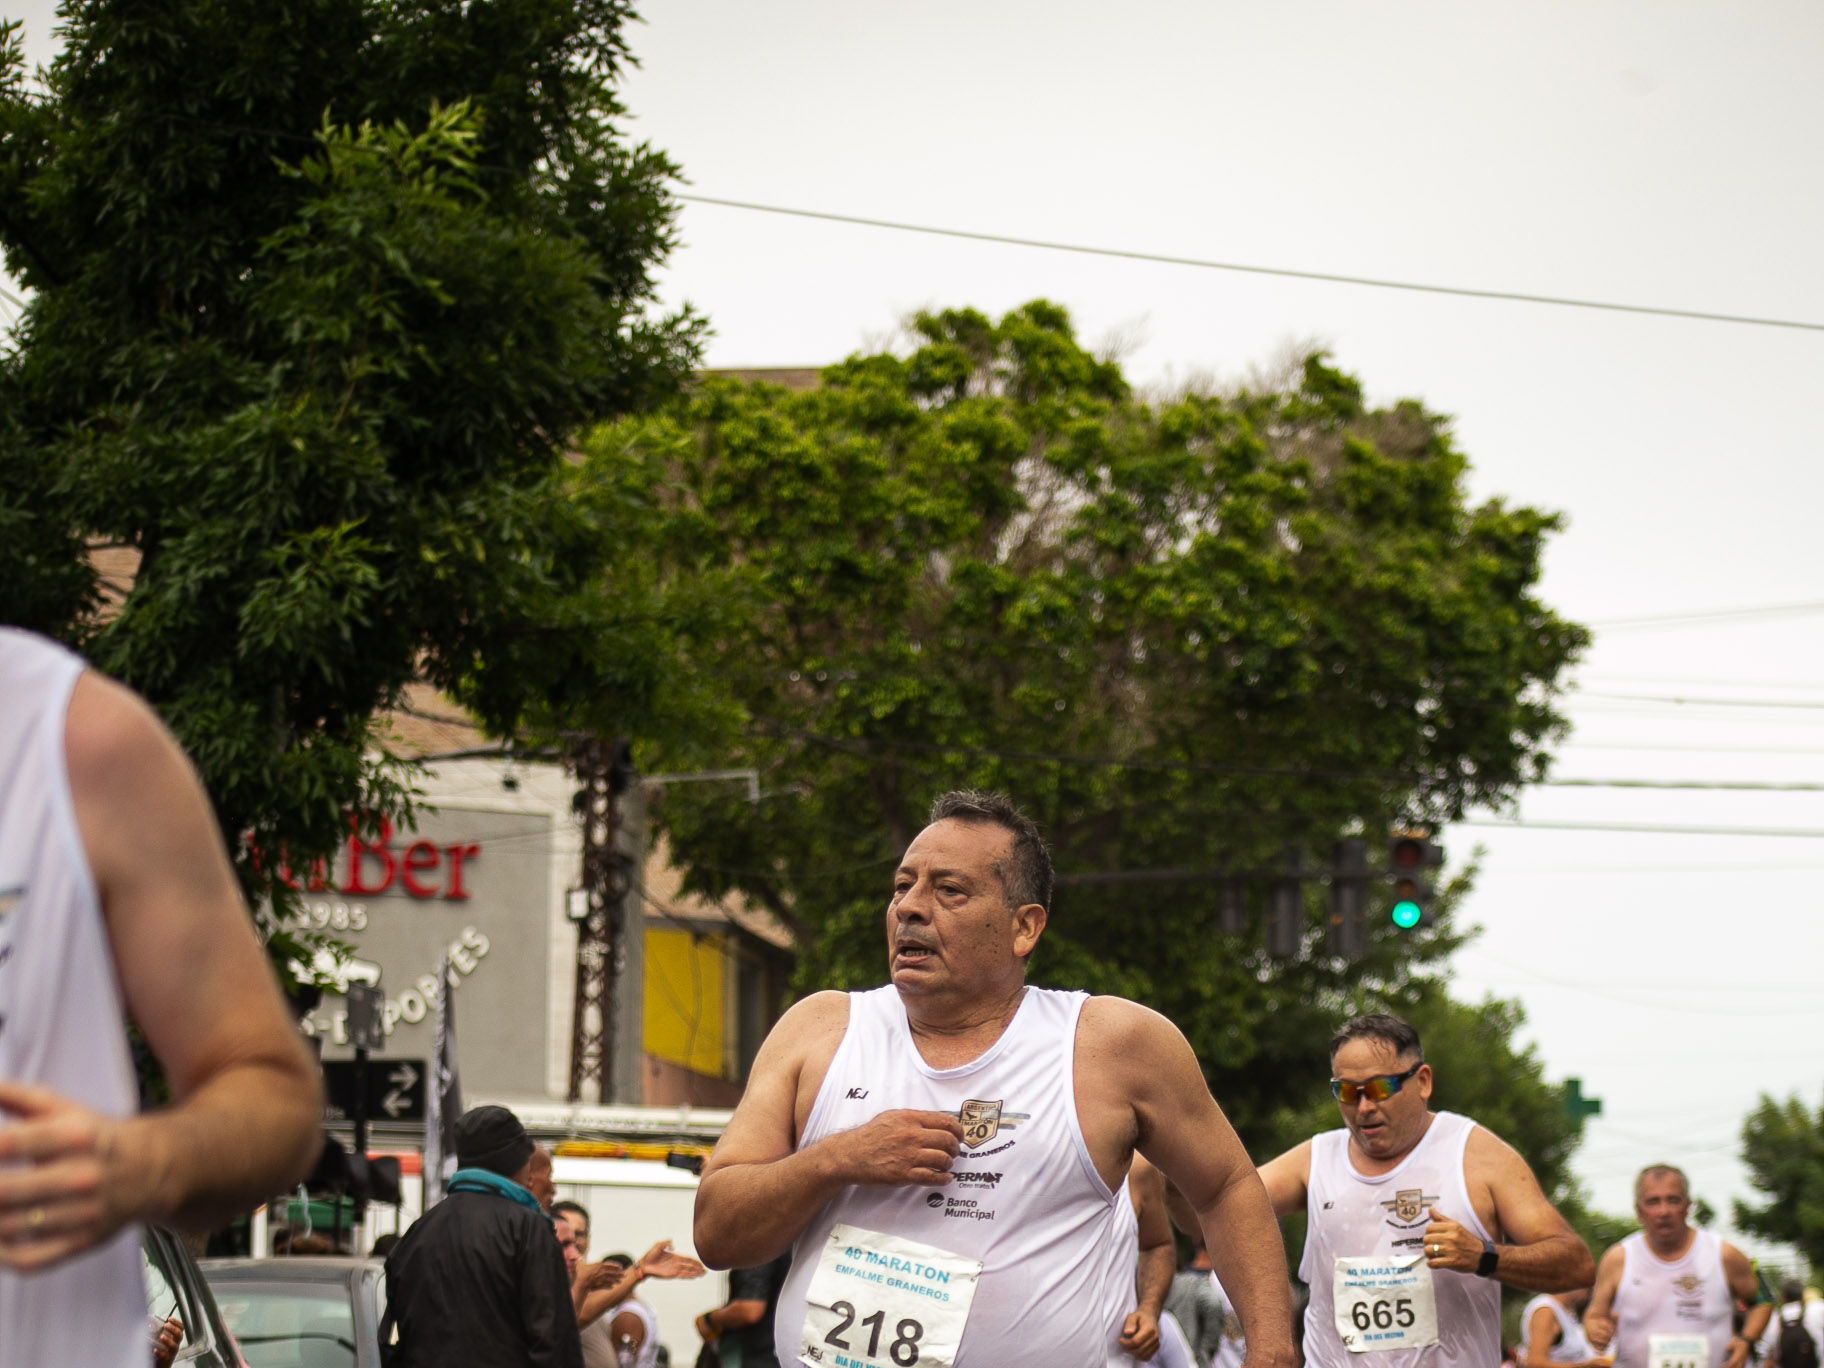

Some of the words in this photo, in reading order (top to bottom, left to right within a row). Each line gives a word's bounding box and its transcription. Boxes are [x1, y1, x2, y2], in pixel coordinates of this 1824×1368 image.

[299, 902, 368, 930] 1985
[846, 1088, 869, 1099] NEJ
[965, 1124, 988, 1139] 40
[969, 1140, 1016, 1158] GRANEROS
[947, 1197, 978, 1208] Banco
[944, 1208, 995, 1221] Municipal
[845, 1247, 862, 1261] 40
[866, 1251, 951, 1284] MARATON
[1361, 1266, 1413, 1276] MARATON
[835, 1264, 883, 1283] EMPALME
[887, 1277, 950, 1302] GRANEROS
[1352, 1299, 1415, 1331] 665
[824, 1300, 924, 1368] 218
[835, 1354, 849, 1367] DIA
